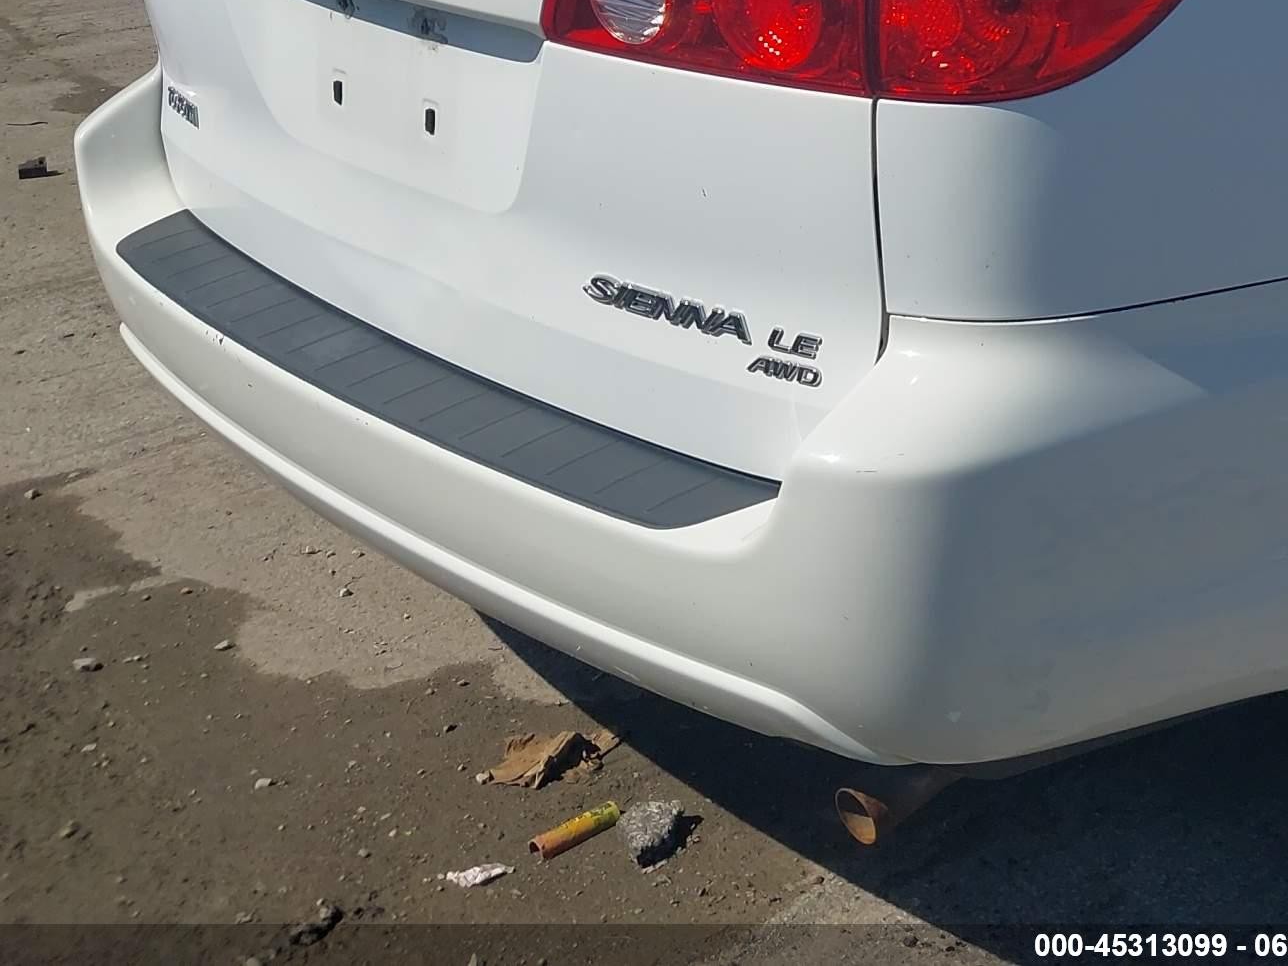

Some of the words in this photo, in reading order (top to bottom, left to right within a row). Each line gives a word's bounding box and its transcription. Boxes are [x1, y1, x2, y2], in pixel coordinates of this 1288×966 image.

[582, 274, 753, 346] SIENNA
[766, 326, 824, 360] LE
[746, 355, 824, 388] AWD
